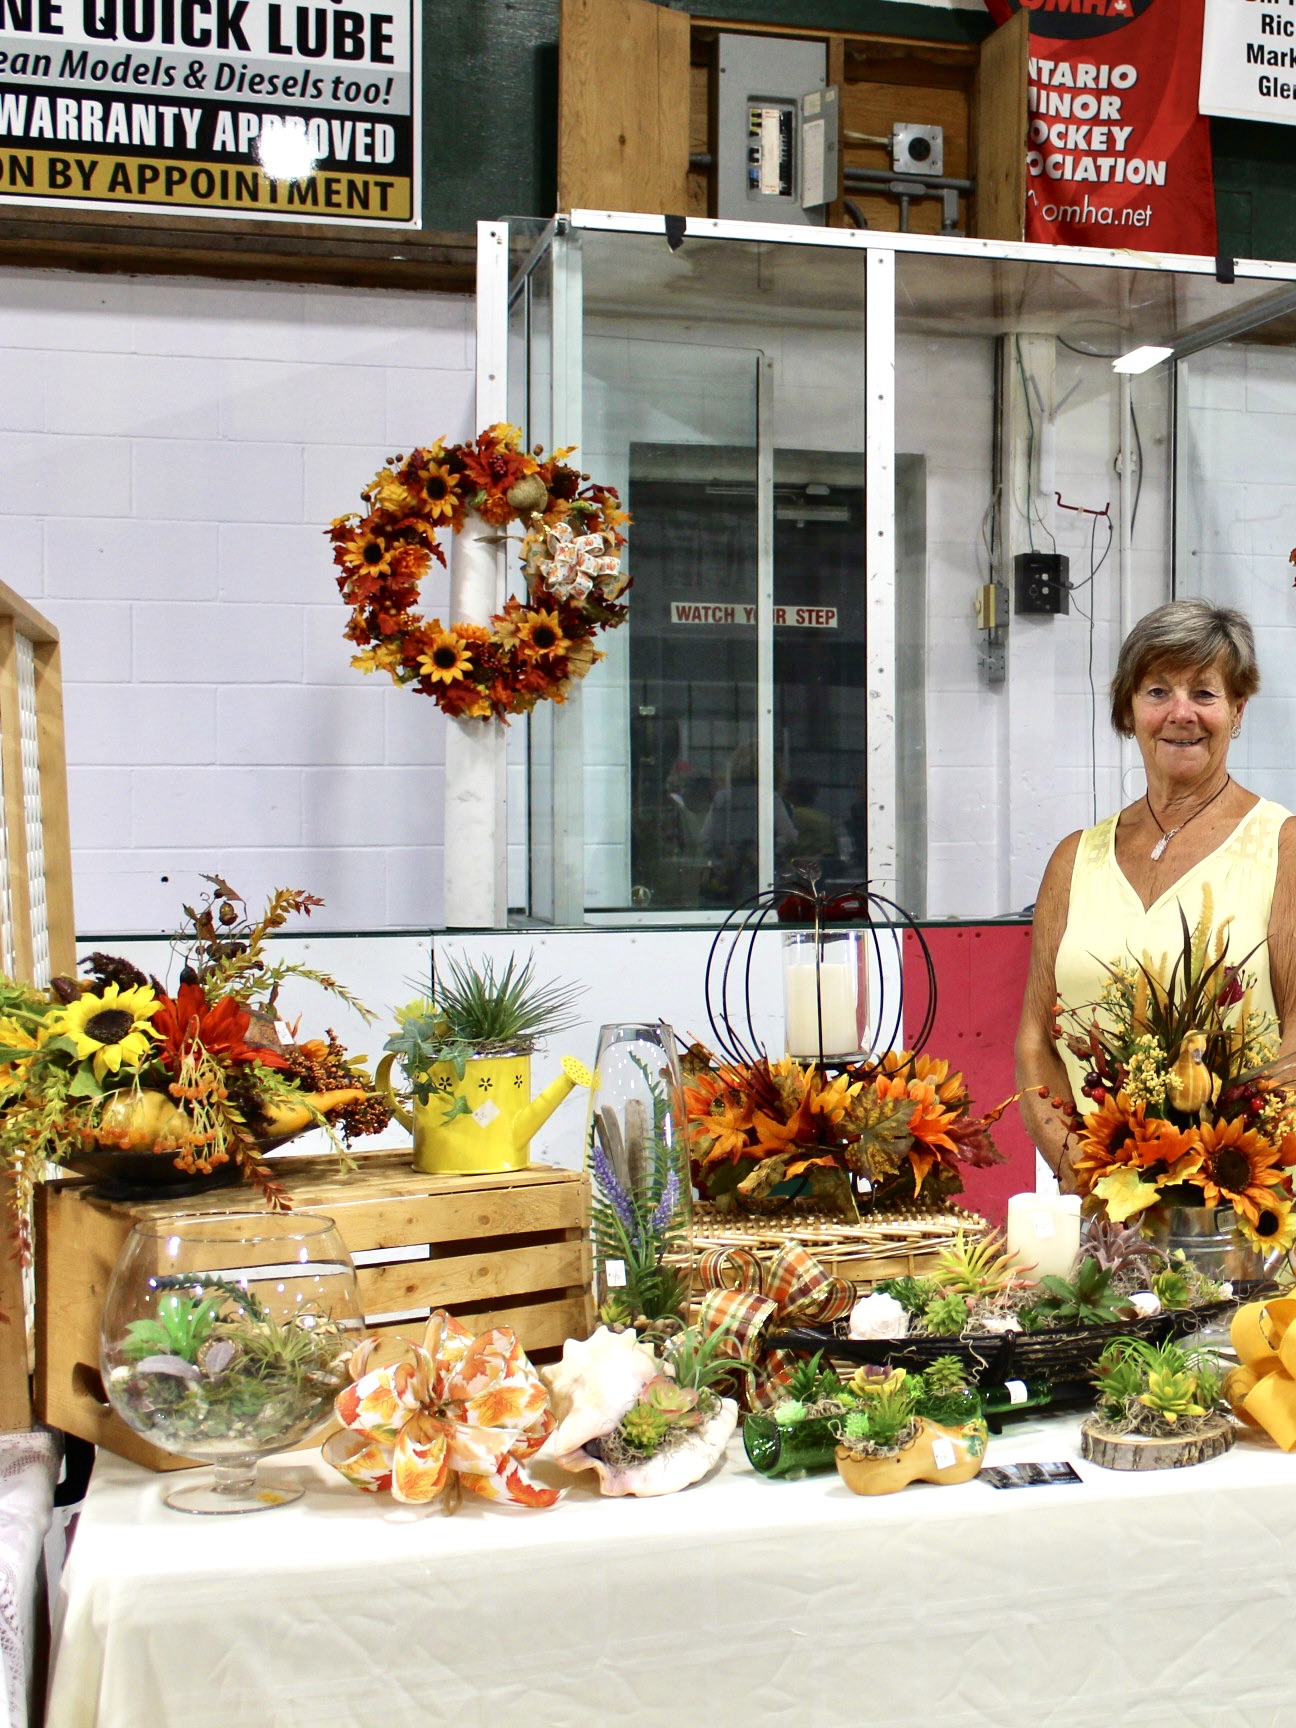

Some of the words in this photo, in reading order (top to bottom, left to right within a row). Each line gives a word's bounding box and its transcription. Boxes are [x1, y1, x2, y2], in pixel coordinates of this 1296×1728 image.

[83, 0, 251, 52] QUICK
[268, 3, 394, 64] LUBE
[59, 49, 177, 87] Models
[183, 60, 207, 90] &
[214, 63, 325, 99] Diesels
[331, 76, 394, 105] too!
[0, 93, 202, 150] WARRANTY
[213, 110, 395, 164] APOVED
[0, 155, 34, 187] N
[49, 157, 99, 191] BY
[108, 161, 395, 211] APPOINTMENT
[1041, 194, 1153, 227] omha.net
[676, 605, 735, 623] WATCH
[743, 607, 787, 625] YR
[796, 608, 836, 626] STEP
